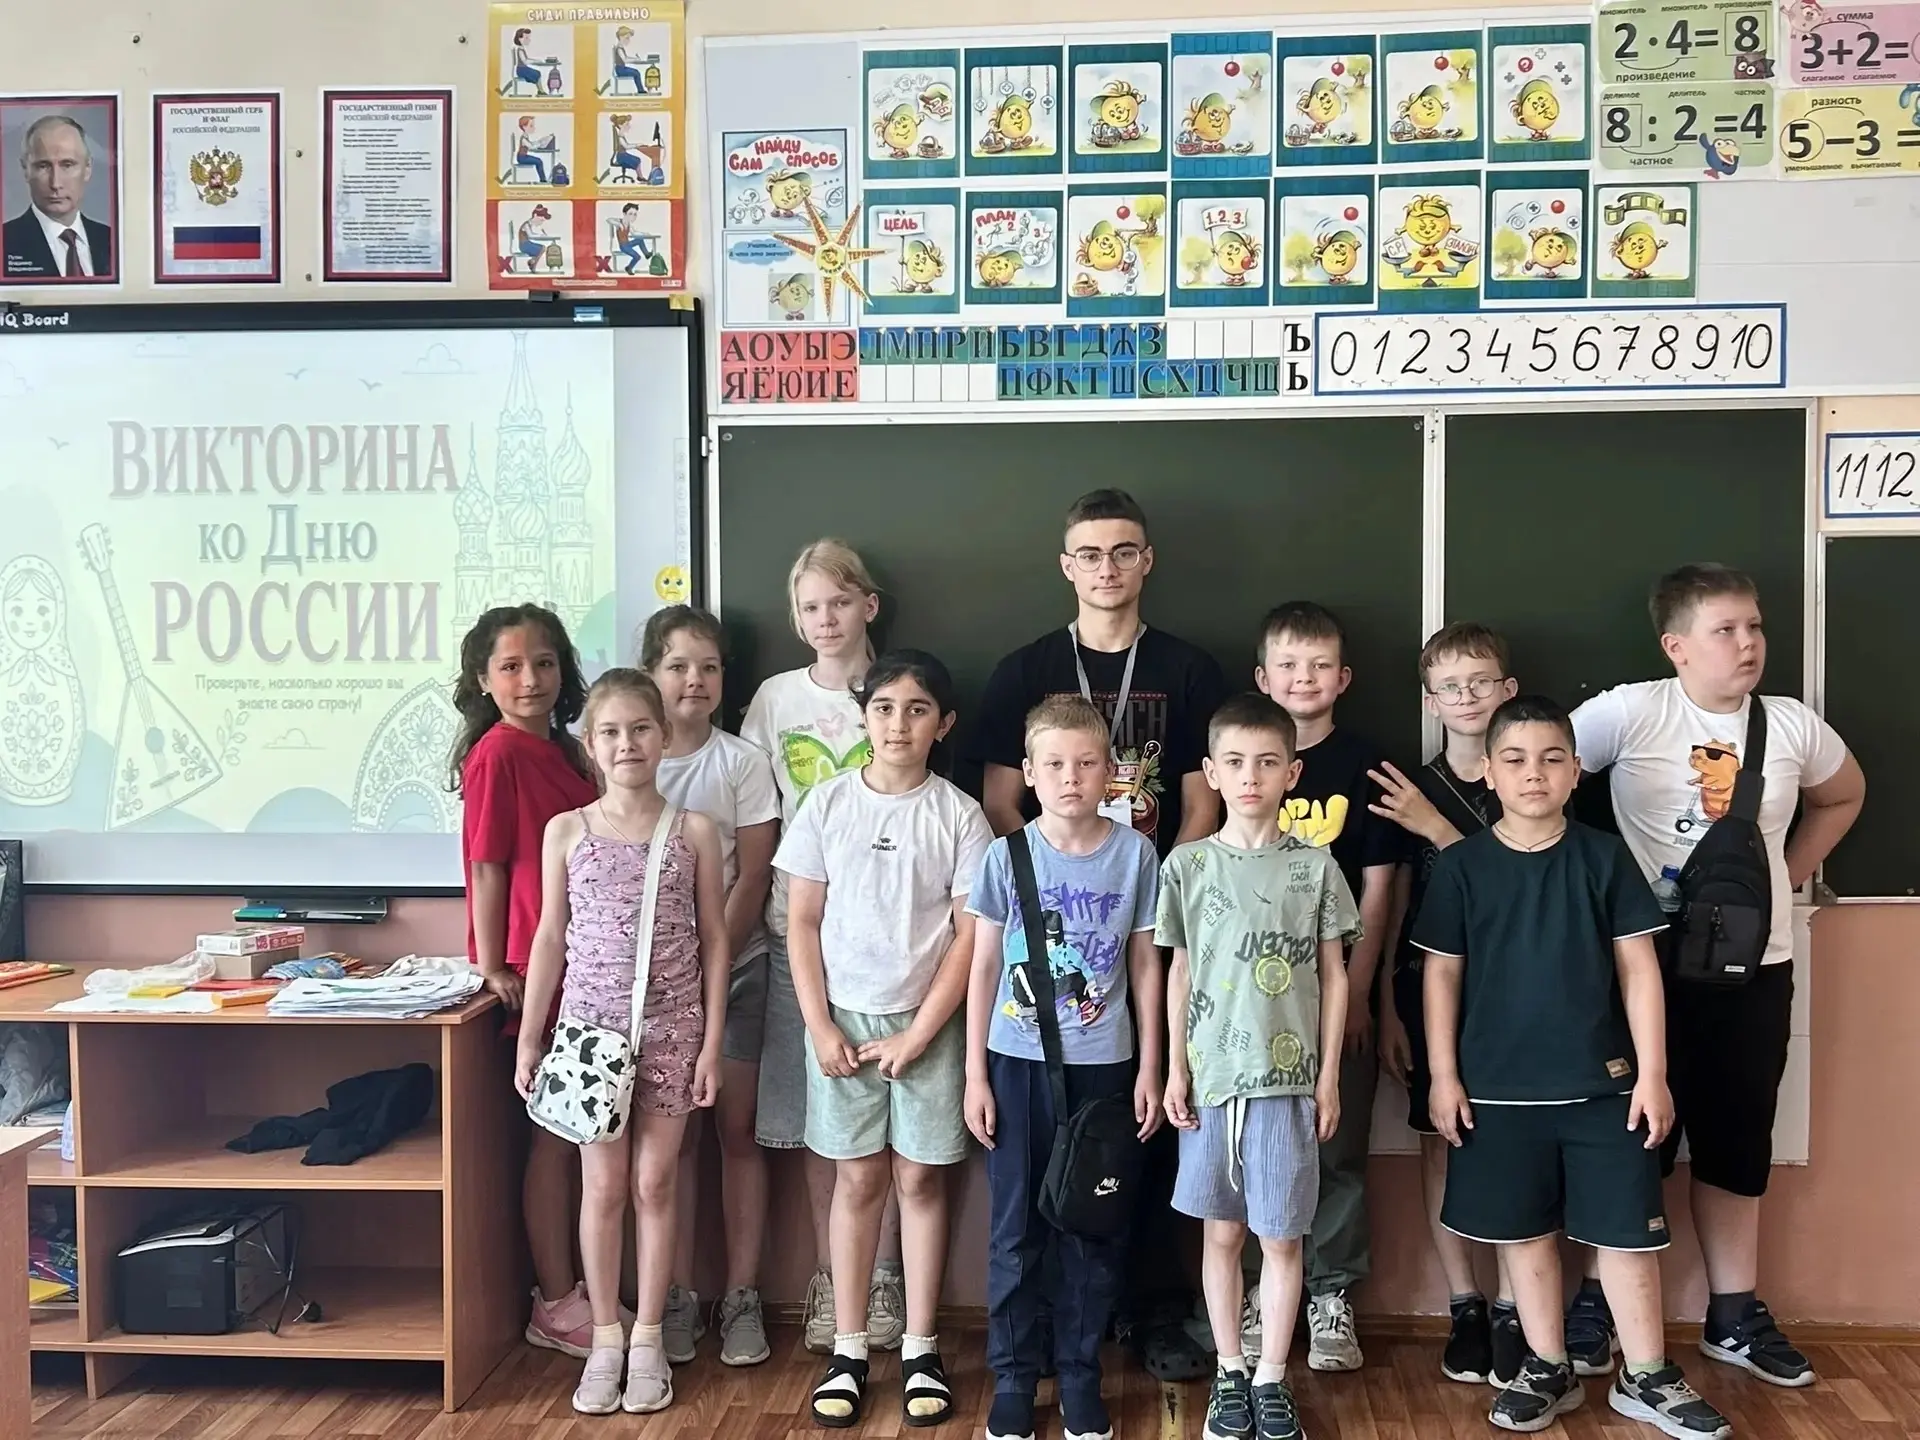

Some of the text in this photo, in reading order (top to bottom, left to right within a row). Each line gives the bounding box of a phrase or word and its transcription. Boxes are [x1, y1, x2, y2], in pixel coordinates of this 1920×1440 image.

[527, 7, 650, 21] СИДИ ПРАВИЛЬНО
[1600, 8, 1646, 16] множитель
[1661, 4, 1708, 12] множитель
[1837, 12, 1873, 22] сумма
[1616, 70, 1696, 83] произведение
[1603, 88, 1766, 100] делимое делитель частное
[339, 103, 413, 111] ГОСУДАРСТВЕННЫЙ
[1811, 97, 1862, 108] разность
[170, 106, 243, 115] ГОСУДАРСТВЕННЫЙ
[754, 137, 801, 155] НАЙДУ
[729, 152, 838, 170] САМ СПОСОБ
[1629, 157, 1674, 167] частное
[1851, 161, 1901, 169] вычитаемое
[884, 217, 918, 232] ЦЕЛЬ
[976, 210, 1016, 228] ПЛАН
[22, 312, 69, 327] Board
[1284, 323, 1311, 352] Ъ
[1287, 362, 1308, 391] Ь
[107, 420, 462, 498] ВИКТОРИНА
[1876, 452, 1915, 497] 12
[150, 580, 442, 663] РОССИИ
[195, 674, 404, 692] Проверьте, насколько хорошо вы
[237, 695, 363, 714] знаете свою страну!
